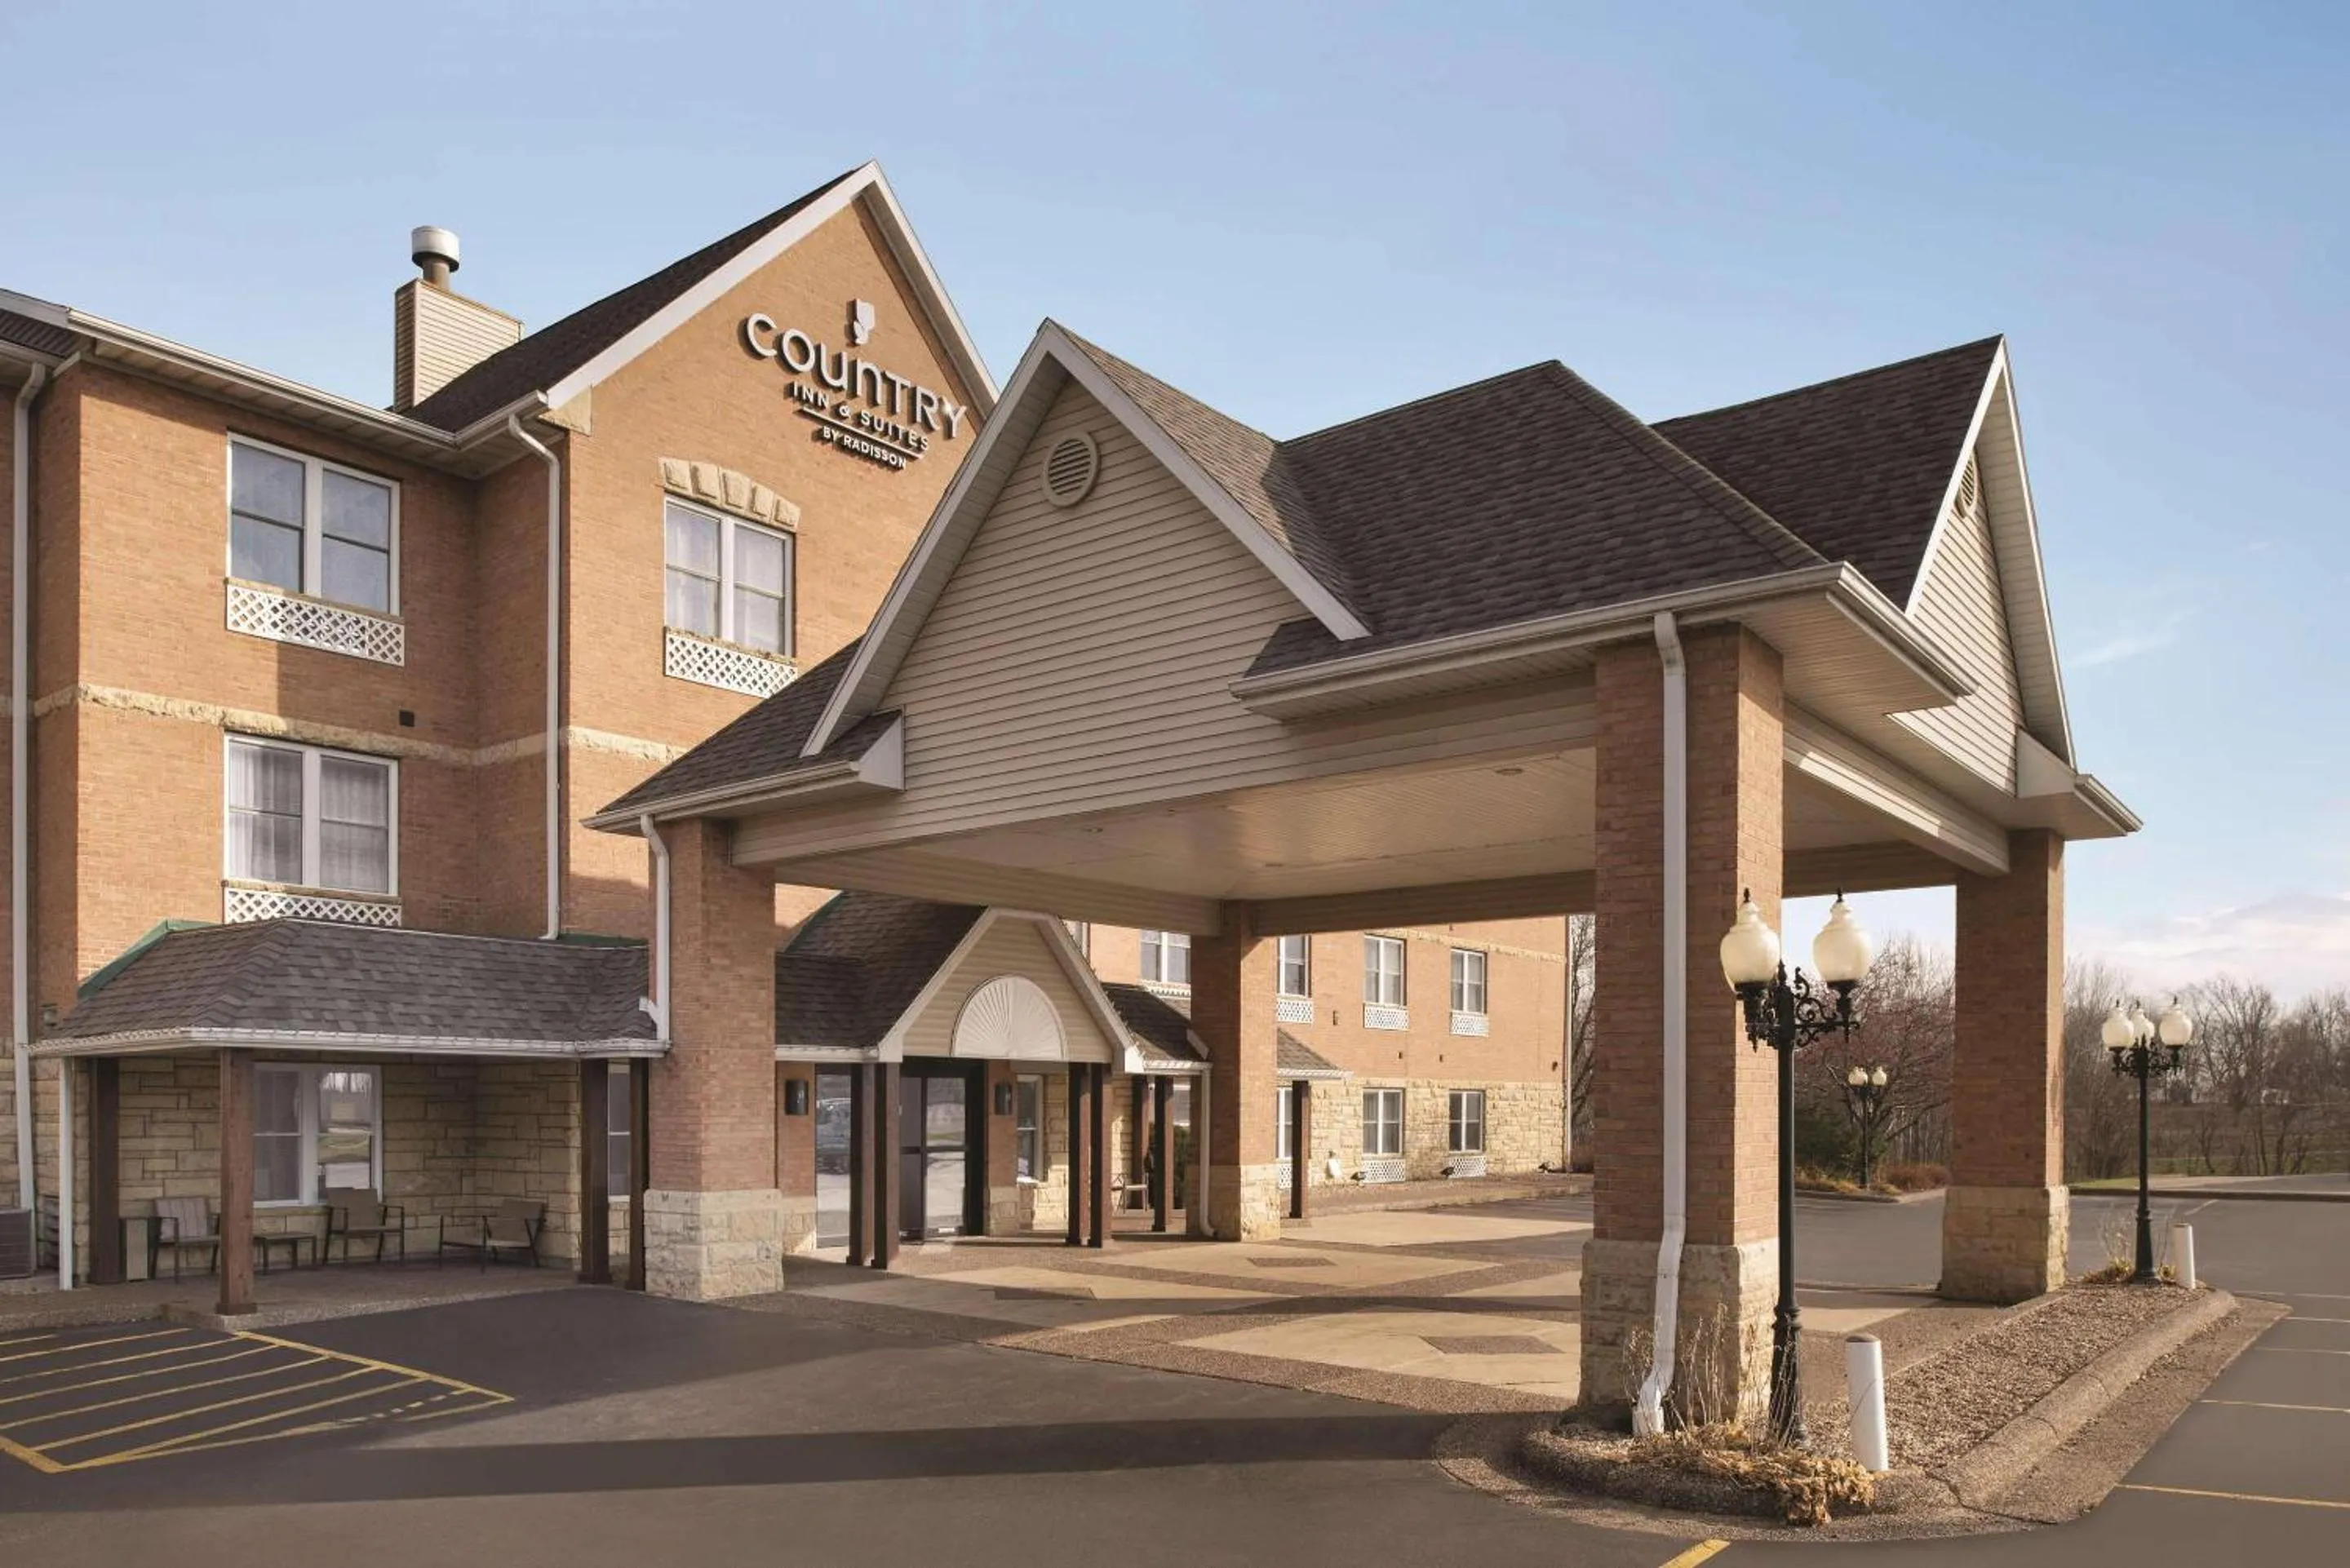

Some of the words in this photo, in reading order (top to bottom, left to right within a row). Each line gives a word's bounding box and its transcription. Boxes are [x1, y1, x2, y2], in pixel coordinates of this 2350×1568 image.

[791, 380, 830, 410] INN
[839, 403, 851, 419] &
[860, 410, 929, 451] SUITES
[822, 425, 843, 444] BY
[844, 434, 907, 471] RADISSON
